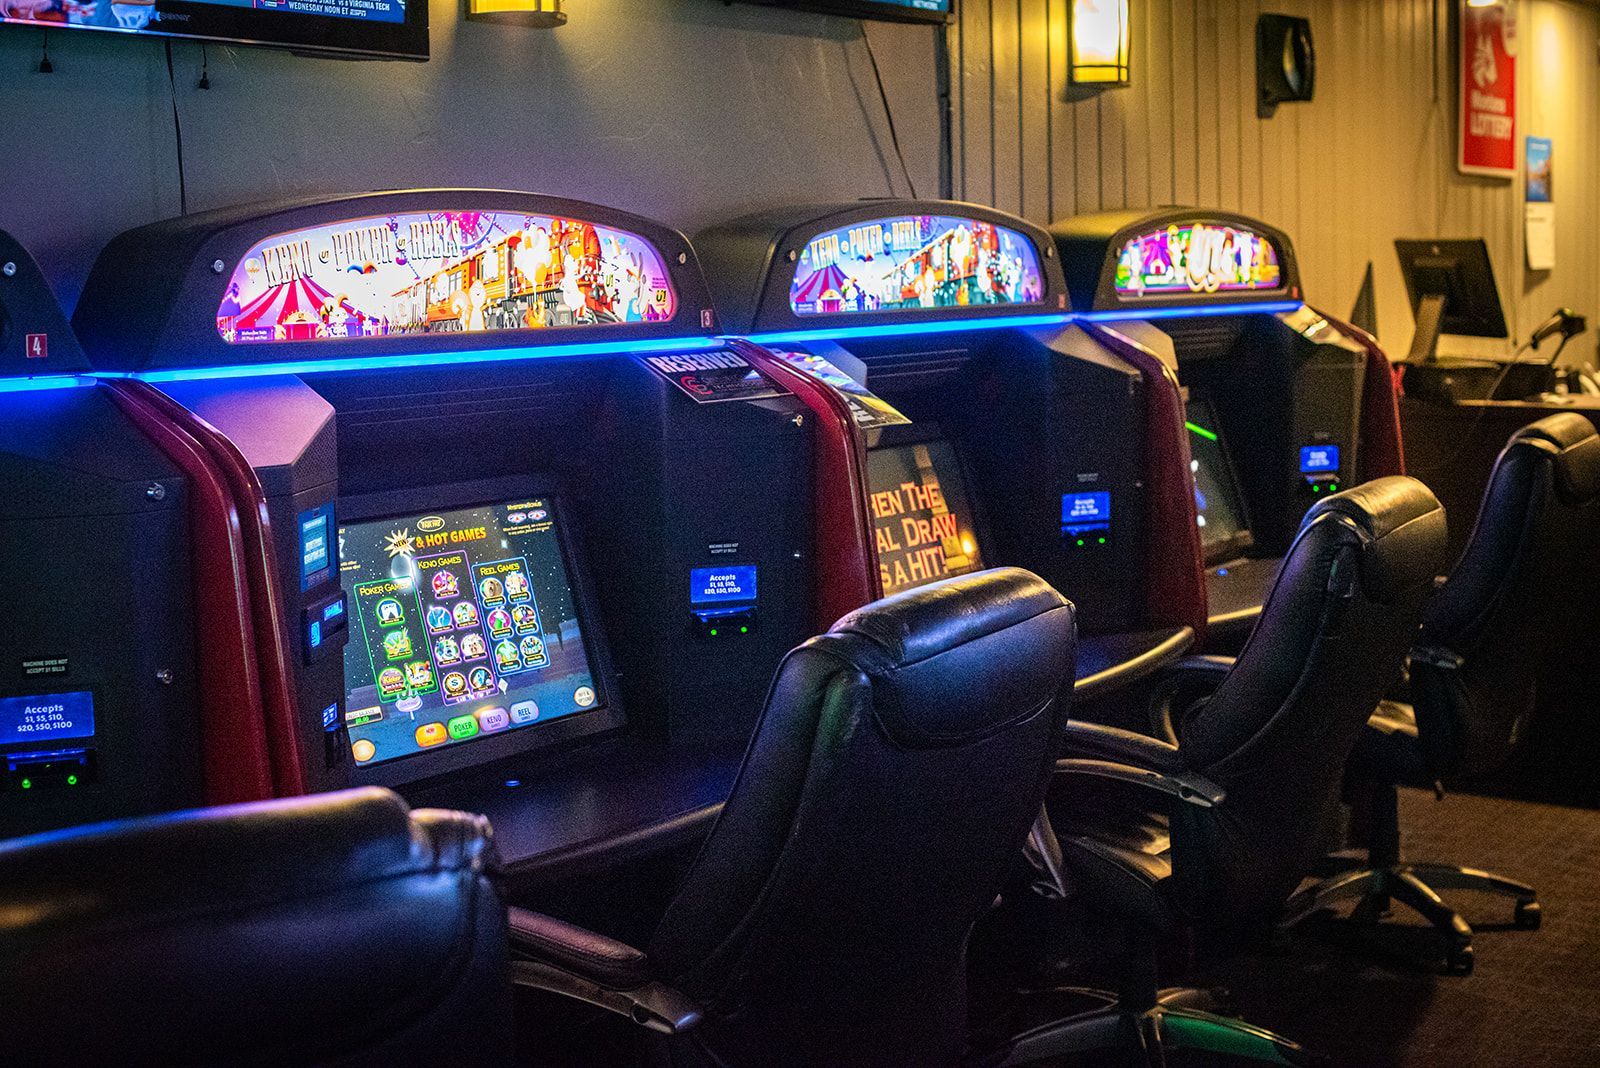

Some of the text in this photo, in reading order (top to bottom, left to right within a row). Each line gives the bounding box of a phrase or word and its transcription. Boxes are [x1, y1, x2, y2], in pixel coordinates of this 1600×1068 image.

[288, 1, 323, 12] WEDNESDAY
[324, 5, 341, 14] NOON
[341, 7, 349, 15] ET
[349, 0, 375, 9] VIRGINIA
[375, 2, 390, 11] TECH
[849, 224, 883, 256] POKER
[331, 225, 393, 272] POKER
[704, 311, 711, 326] 3
[32, 337, 42, 356] 4
[647, 351, 750, 373] RESERVED
[870, 481, 944, 518] HEN THE
[425, 532, 448, 547] HOT
[450, 527, 487, 542] GAMES
[875, 513, 959, 554] AL DRAW
[894, 560, 910, 586] A
[906, 545, 949, 582] HIT!
[709, 574, 736, 582] Accepts
[24, 704, 64, 714] Accepts
[517, 707, 532, 717] REEL
[48, 713, 64, 721] $10,
[486, 714, 502, 725] KENO
[17, 720, 73, 733] $20, $50, $100
[453, 721, 473, 733] POKER
